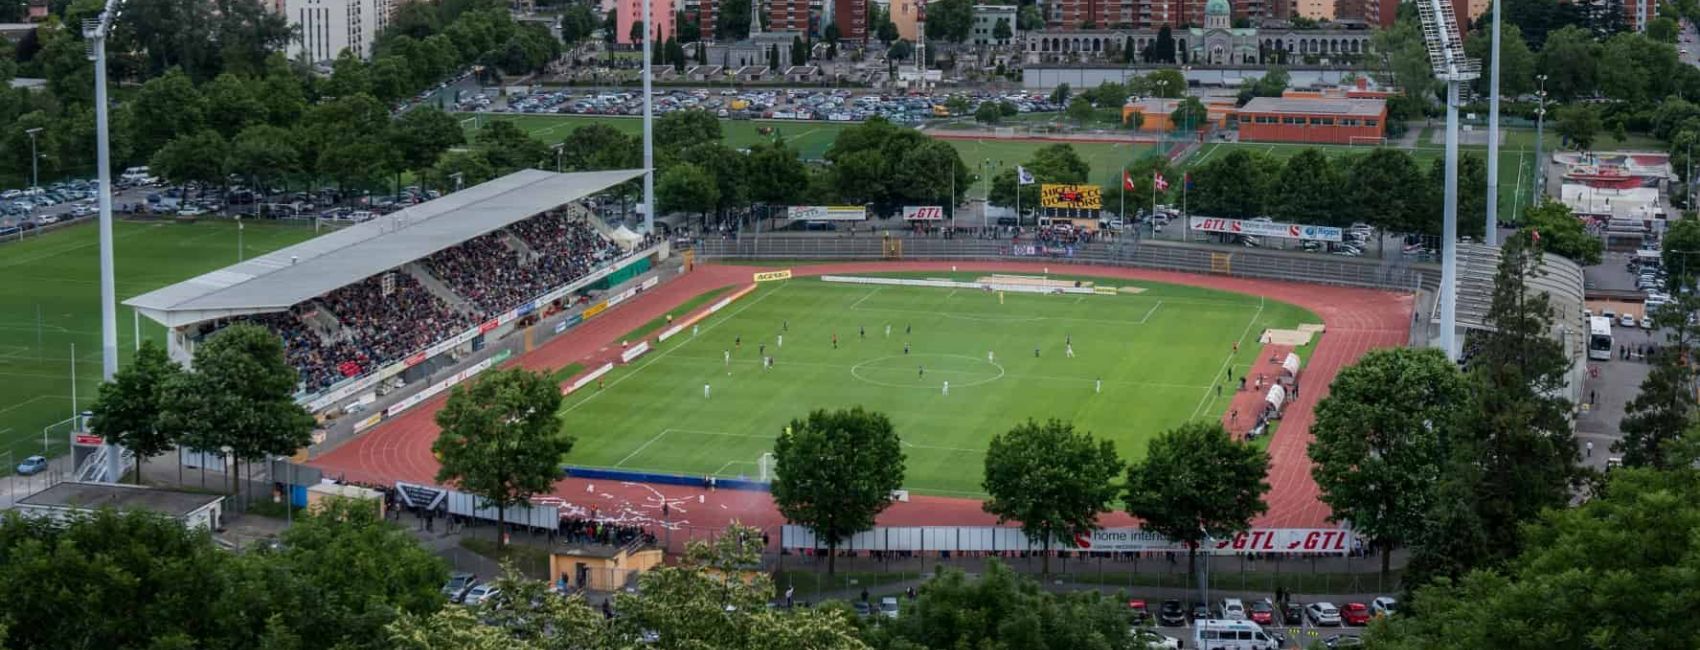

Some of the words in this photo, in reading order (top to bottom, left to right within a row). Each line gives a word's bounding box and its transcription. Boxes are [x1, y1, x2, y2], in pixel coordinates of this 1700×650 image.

[917, 208, 939, 218] GTL
[1203, 219, 1226, 230] GTL
[1094, 529, 1127, 541] home
[1232, 531, 1273, 549] GTL
[1303, 531, 1346, 549] GTL
